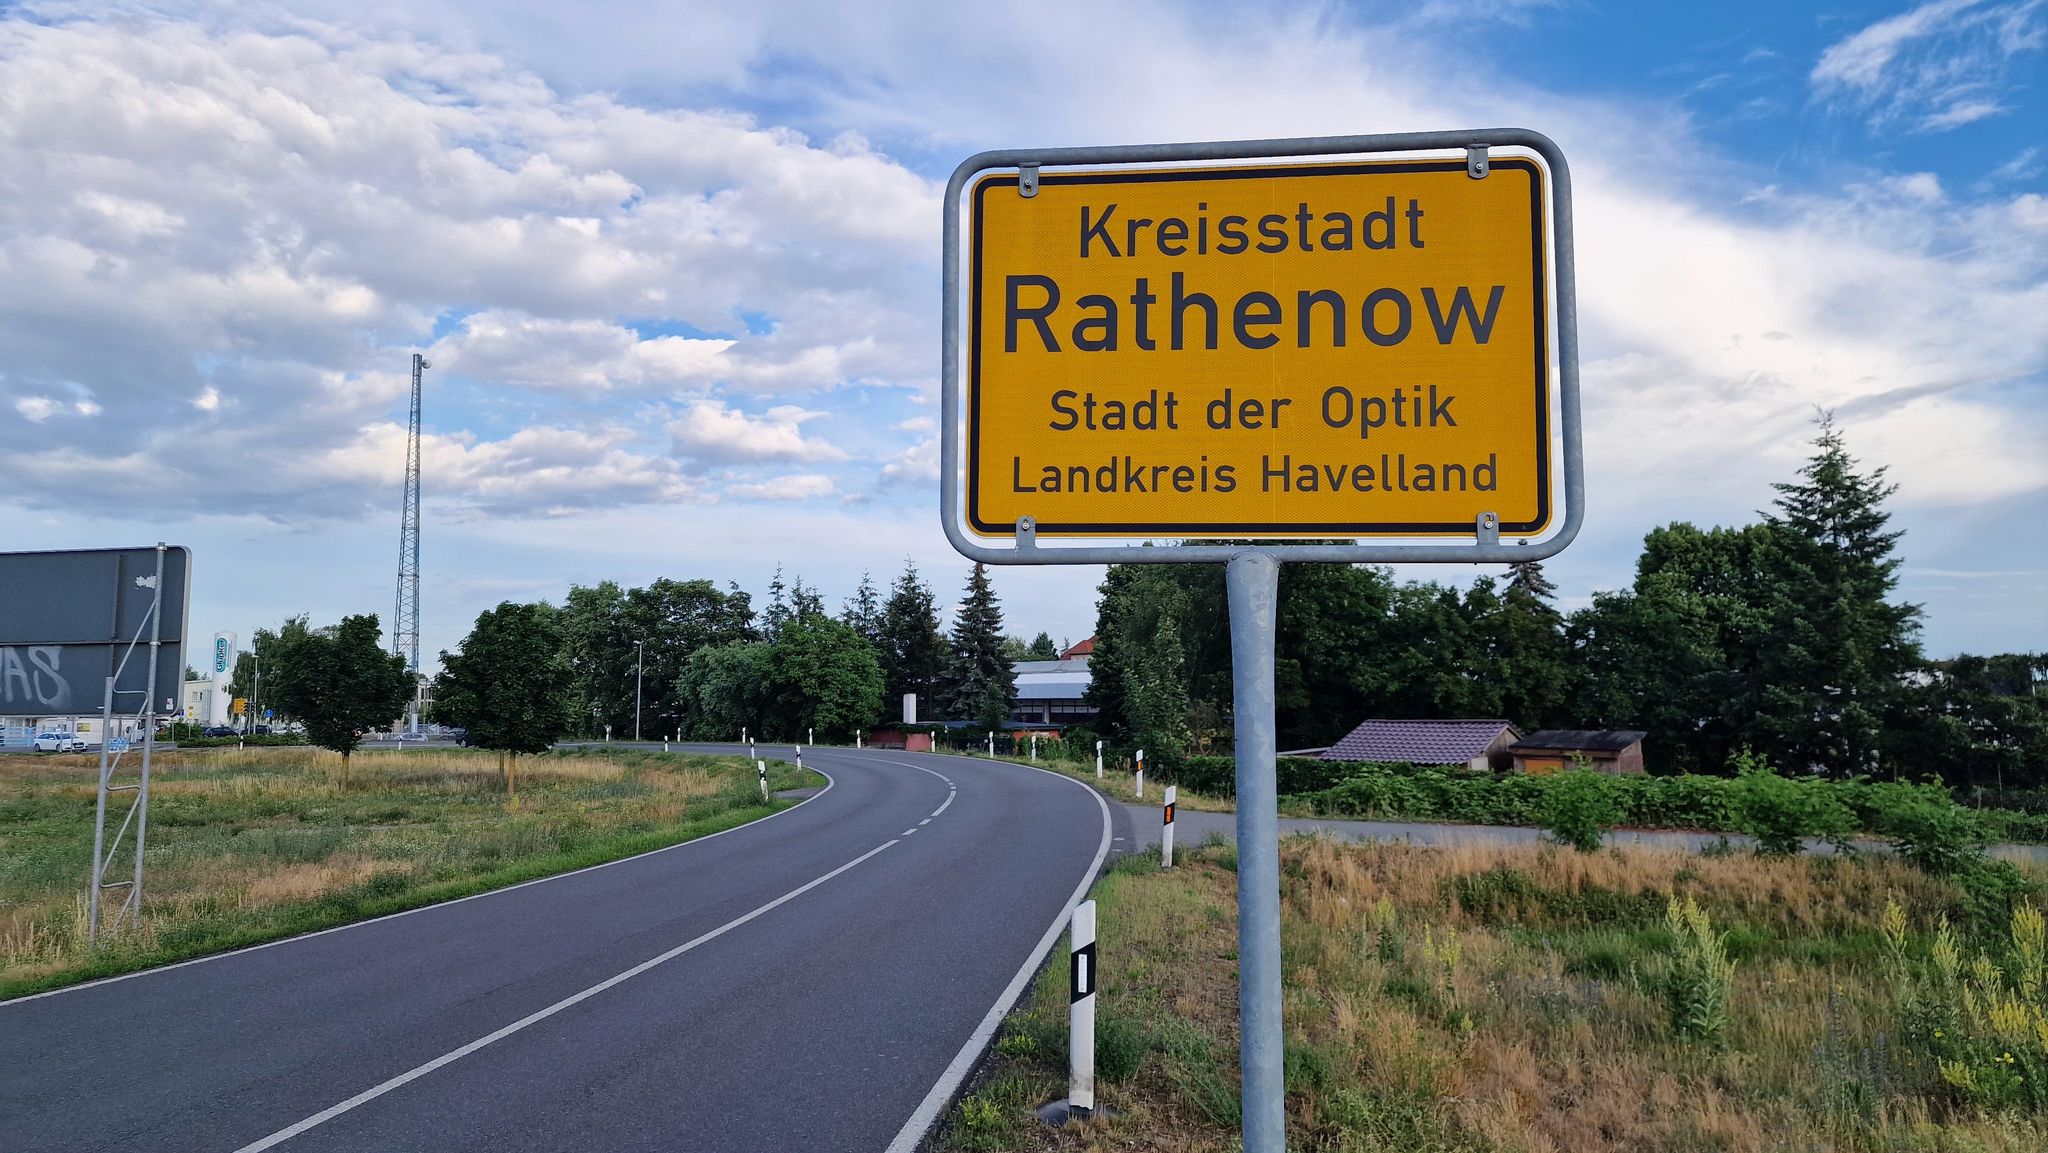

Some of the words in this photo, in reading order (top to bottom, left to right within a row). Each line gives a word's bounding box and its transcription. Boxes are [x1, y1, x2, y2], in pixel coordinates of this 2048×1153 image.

[1080, 196, 1425, 258] Kreisstadt
[1005, 272, 1505, 352] Rathenow
[1049, 388, 1178, 431] Stadt
[1207, 386, 1292, 429] der
[1322, 385, 1457, 439] Optik
[1014, 453, 1236, 492] Landkreis
[1263, 453, 1496, 492] Havelland
[0, 648, 70, 706] AS
